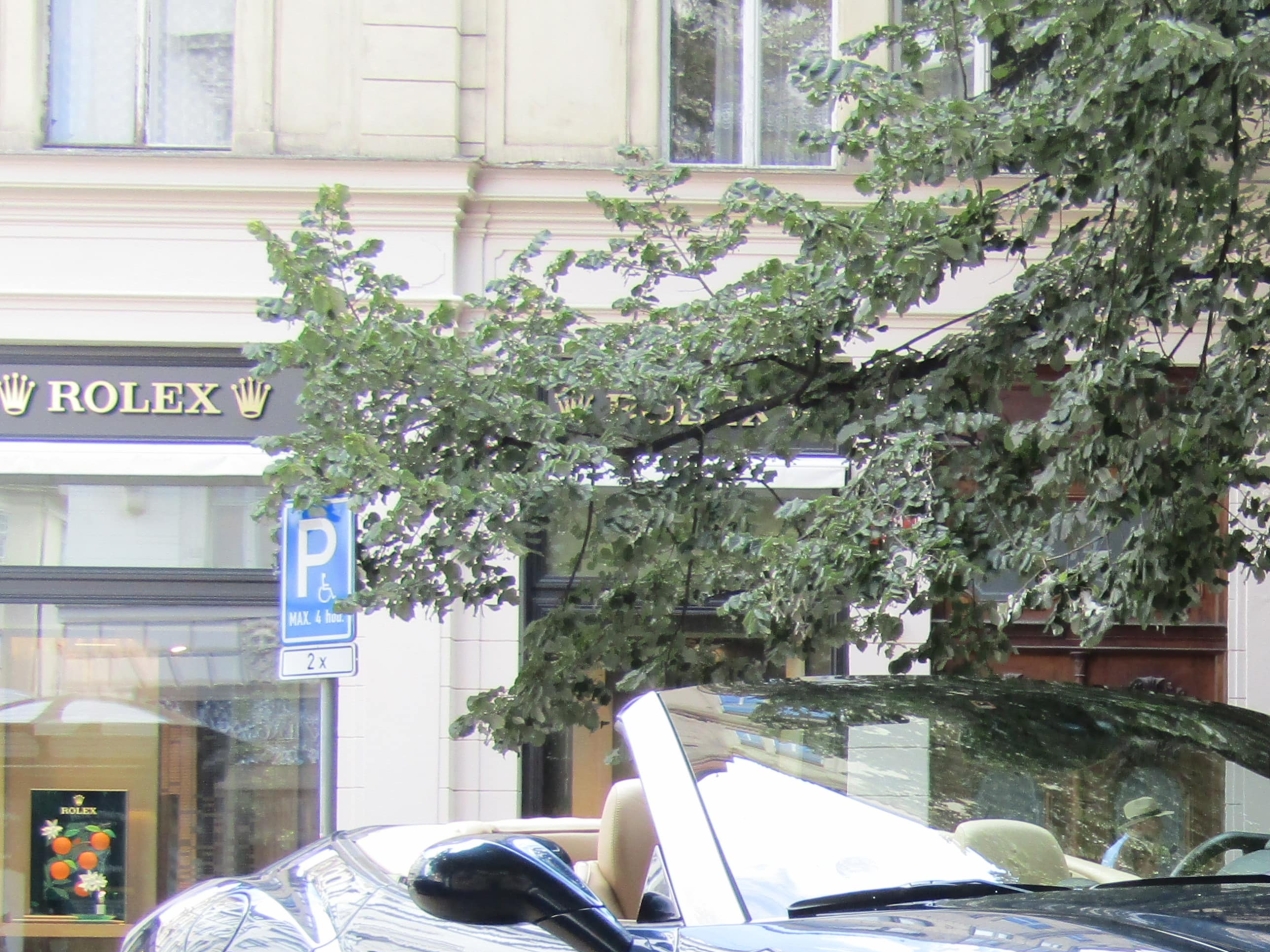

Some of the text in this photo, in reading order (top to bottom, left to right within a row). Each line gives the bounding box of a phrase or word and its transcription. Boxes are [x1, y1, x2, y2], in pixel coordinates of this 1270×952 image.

[48, 380, 222, 414] ROLEX
[298, 517, 337, 598] P
[289, 611, 311, 627] MAX.
[315, 610, 322, 624] 4
[307, 652, 315, 670] 2
[60, 806, 98, 815] ROLEX
